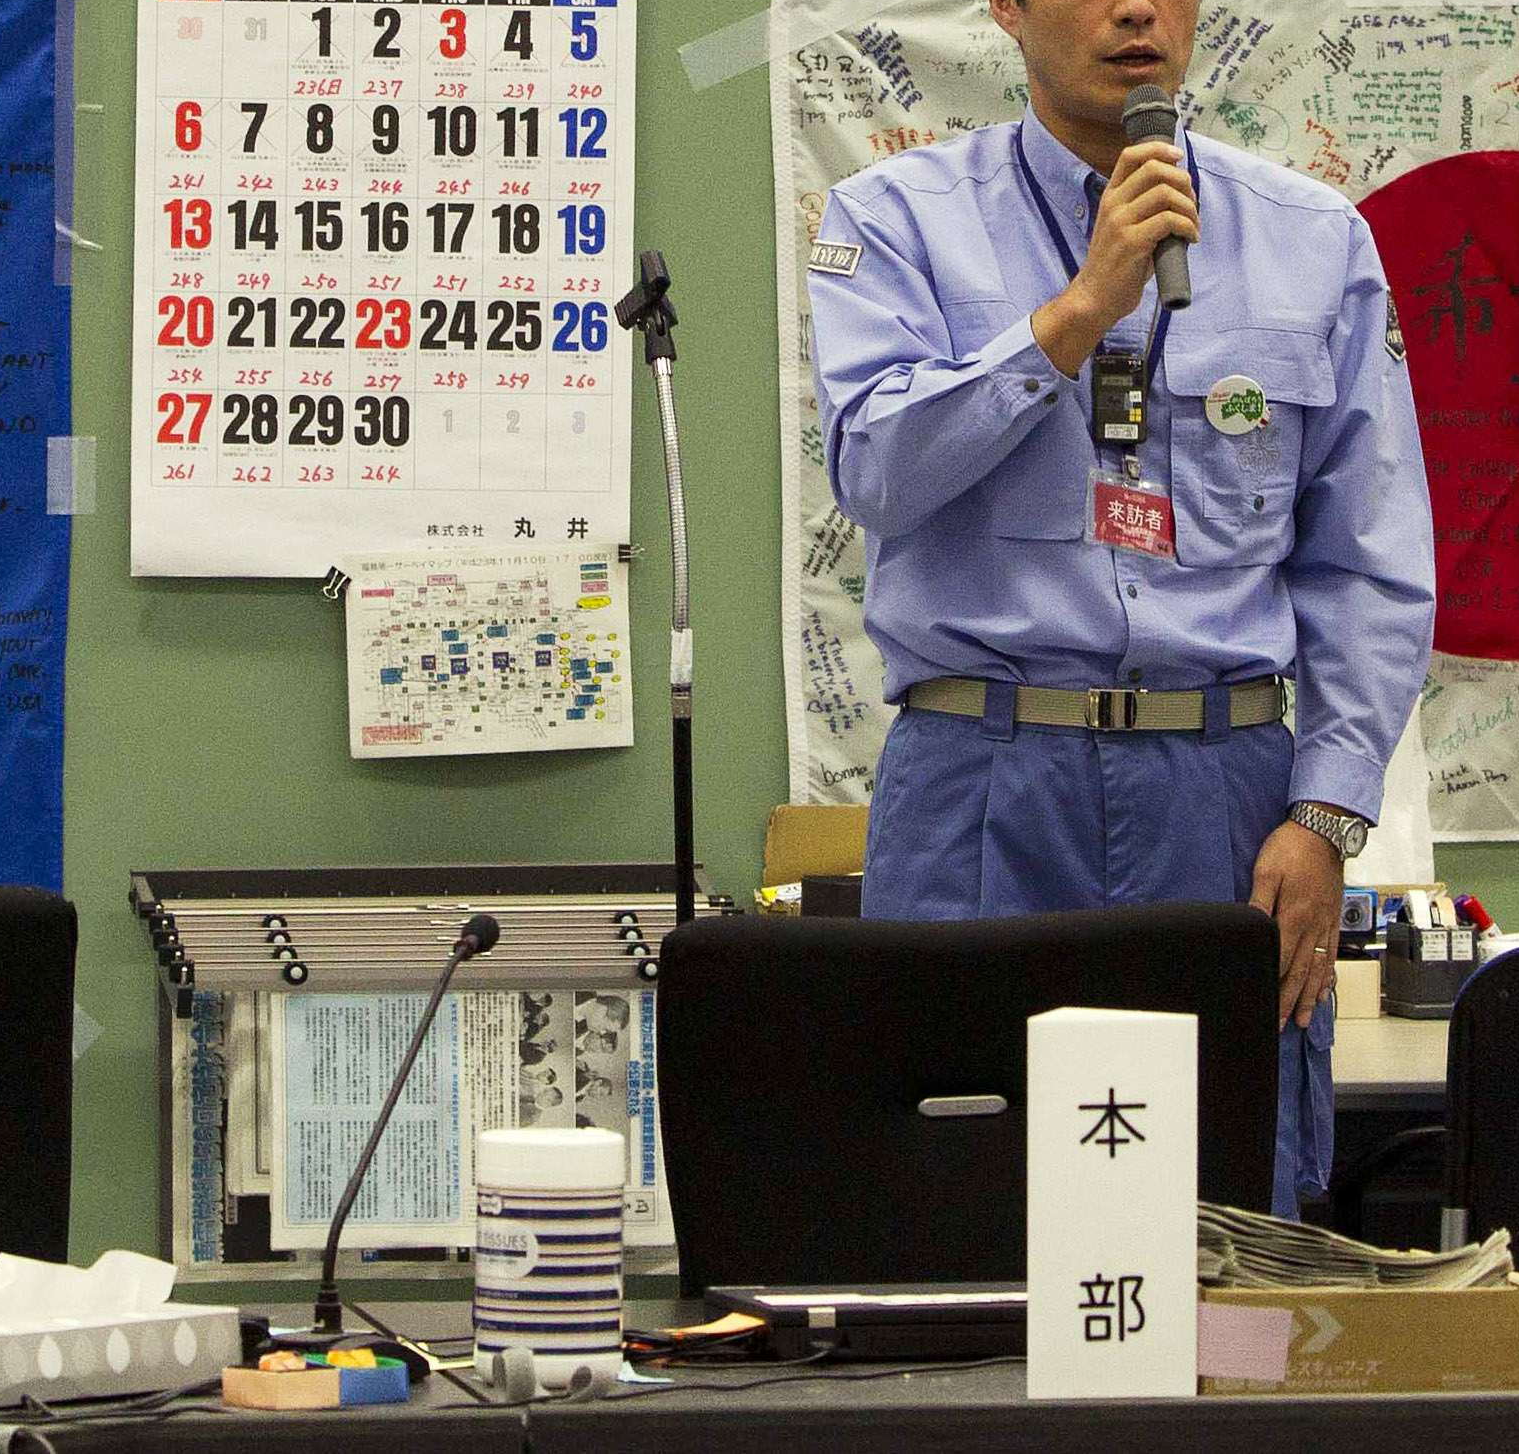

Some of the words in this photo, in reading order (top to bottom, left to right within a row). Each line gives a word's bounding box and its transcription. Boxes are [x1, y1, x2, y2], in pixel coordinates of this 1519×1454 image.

[312, 7, 331, 57] 1
[373, 7, 401, 58] 2
[439, 9, 466, 59] 3
[504, 10, 533, 60] 4
[571, 11, 597, 61] 5
[175, 101, 202, 151] 6
[241, 102, 268, 153] 7
[306, 103, 334, 154] 8
[372, 104, 400, 155] 9
[427, 105, 477, 157] 10
[497, 107, 539, 157] 11
[559, 108, 607, 158] 12
[164, 199, 212, 249] 13
[227, 200, 279, 250] 14
[295, 201, 343, 251] 15
[360, 202, 409, 252] 16
[426, 203, 474, 253] 17
[492, 203, 540, 254] 18
[558, 205, 605, 255] 19
[158, 295, 214, 347] 20
[227, 296, 276, 347] 21
[289, 297, 346, 349] 22
[355, 298, 411, 349] 23
[419, 299, 478, 350] 24
[486, 300, 542, 351] 25
[552, 301, 608, 352] 26
[157, 393, 212, 443] 27
[223, 394, 278, 445] 28
[288, 394, 344, 446] 29
[354, 395, 410, 447] 30
[426, 522, 485, 538] 株式会社
[514, 517, 536, 539] 丸
[567, 517, 589, 539] 井
[1107, 499, 1164, 531] 来訪者
